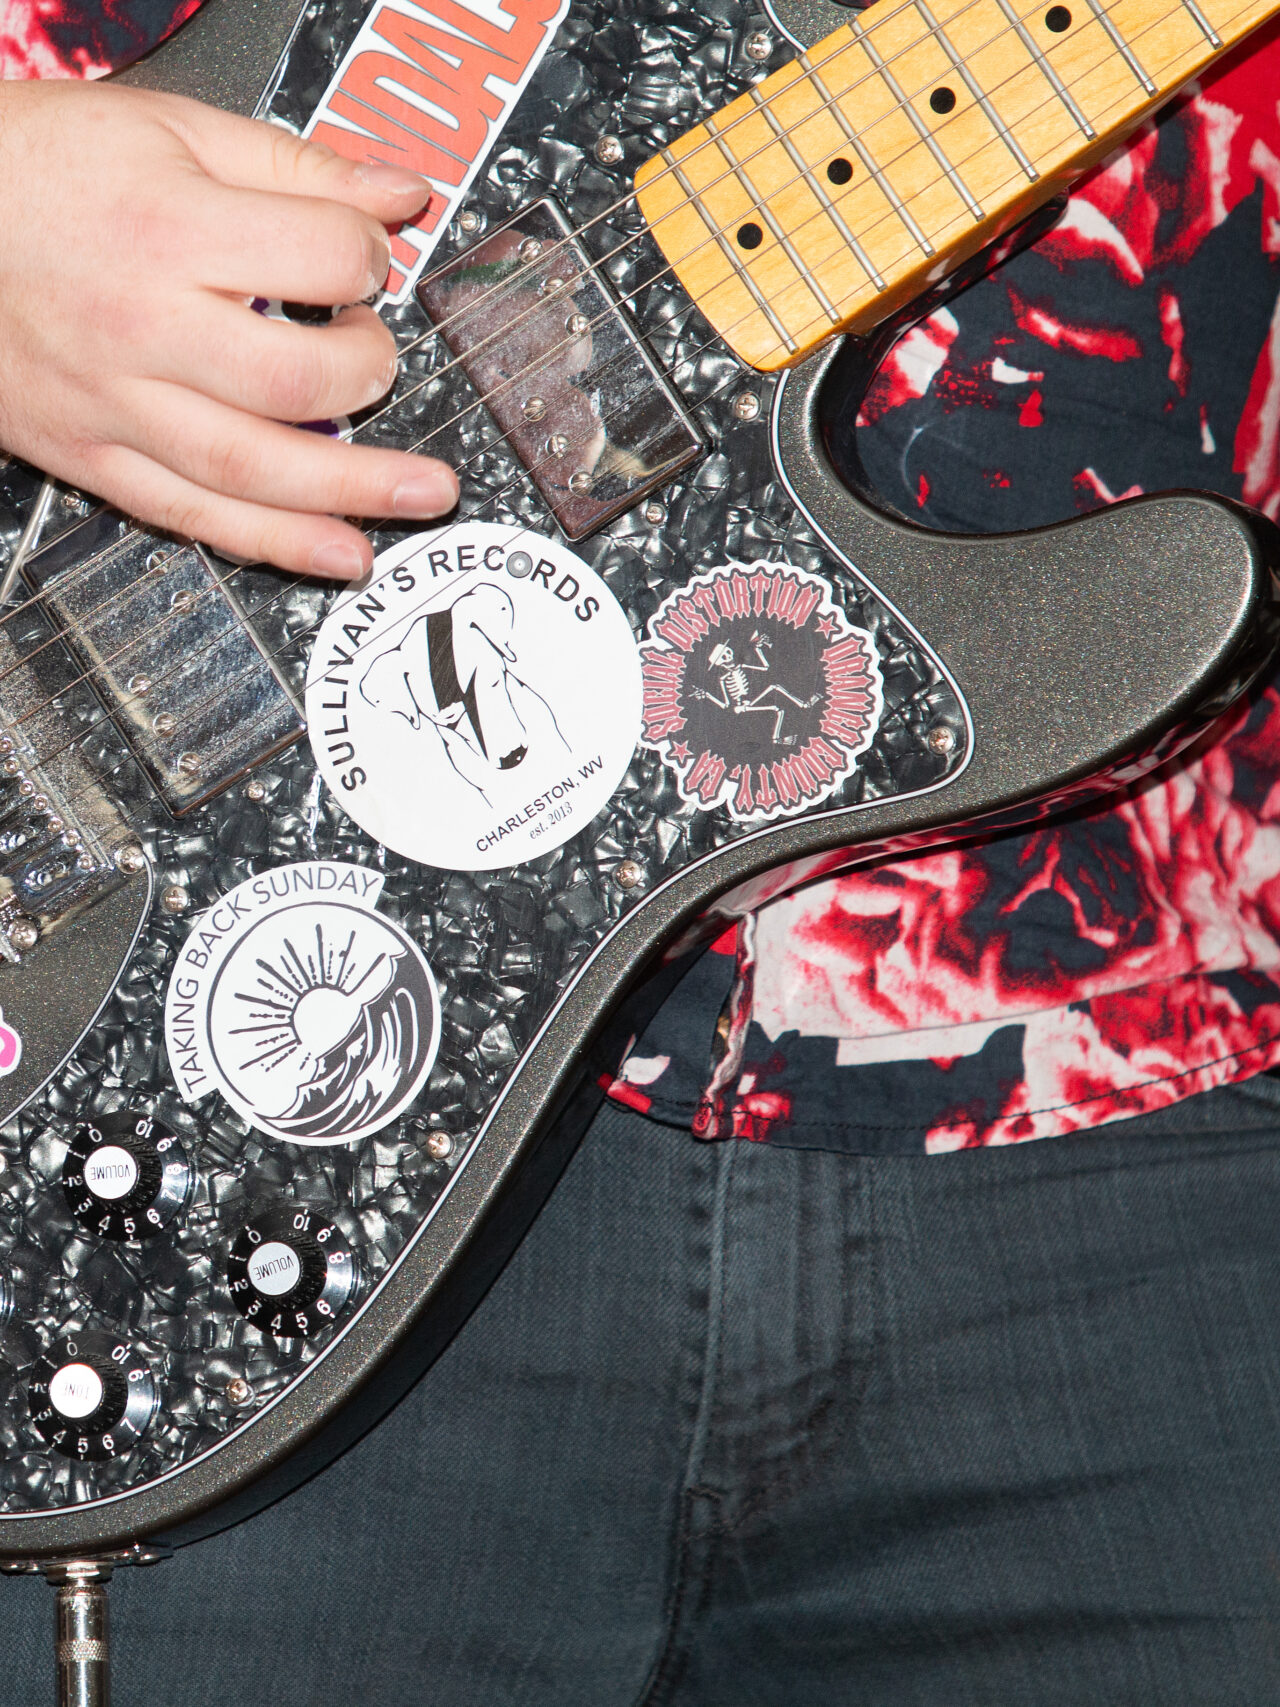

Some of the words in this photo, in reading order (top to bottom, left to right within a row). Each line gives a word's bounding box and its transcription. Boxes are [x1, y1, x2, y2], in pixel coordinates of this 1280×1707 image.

[657, 570, 821, 653] DISTORTION
[322, 566, 416, 791] SULLIVAN'S
[428, 544, 600, 622] RECORDS
[642, 650, 687, 741] SOCIAL
[819, 637, 872, 746] ORANGE
[686, 749, 727, 800] CA
[476, 777, 581, 852] CHARLESTON,
[578, 755, 603, 779] WV
[529, 822, 549, 840] est.
[548, 801, 573, 825] 2013
[252, 866, 379, 905] SUNDAY
[185, 892, 252, 970] BACK
[172, 977, 207, 1094] TAKING
[88, 1128, 103, 1143] 0
[135, 1119, 154, 1139] 10
[156, 1138, 172, 1152] 9
[90, 1164, 131, 1181] VOLUME
[67, 1175, 83, 1188] 2
[78, 1197, 93, 1213] 3
[98, 1214, 111, 1231] 4
[146, 1208, 160, 1224] 6
[293, 1213, 311, 1232] 10
[124, 1217, 136, 1234] 5
[248, 1230, 262, 1244] 0
[316, 1228, 332, 1243] 9
[328, 1252, 345, 1264] 8
[253, 1255, 295, 1281] VOLUME
[233, 1278, 249, 1292] 2
[248, 1299, 263, 1315] 3
[316, 1299, 331, 1315] 6
[271, 1313, 282, 1330] 4
[295, 1312, 309, 1329] 5
[66, 1341, 78, 1356] 0
[111, 1345, 131, 1365] 10
[128, 1369, 144, 1382] 9
[38, 1406, 53, 1421] 3
[120, 1417, 136, 1432] 7
[53, 1430, 67, 1444] 4
[77, 1437, 89, 1454] 5
[102, 1434, 115, 1450] 6
